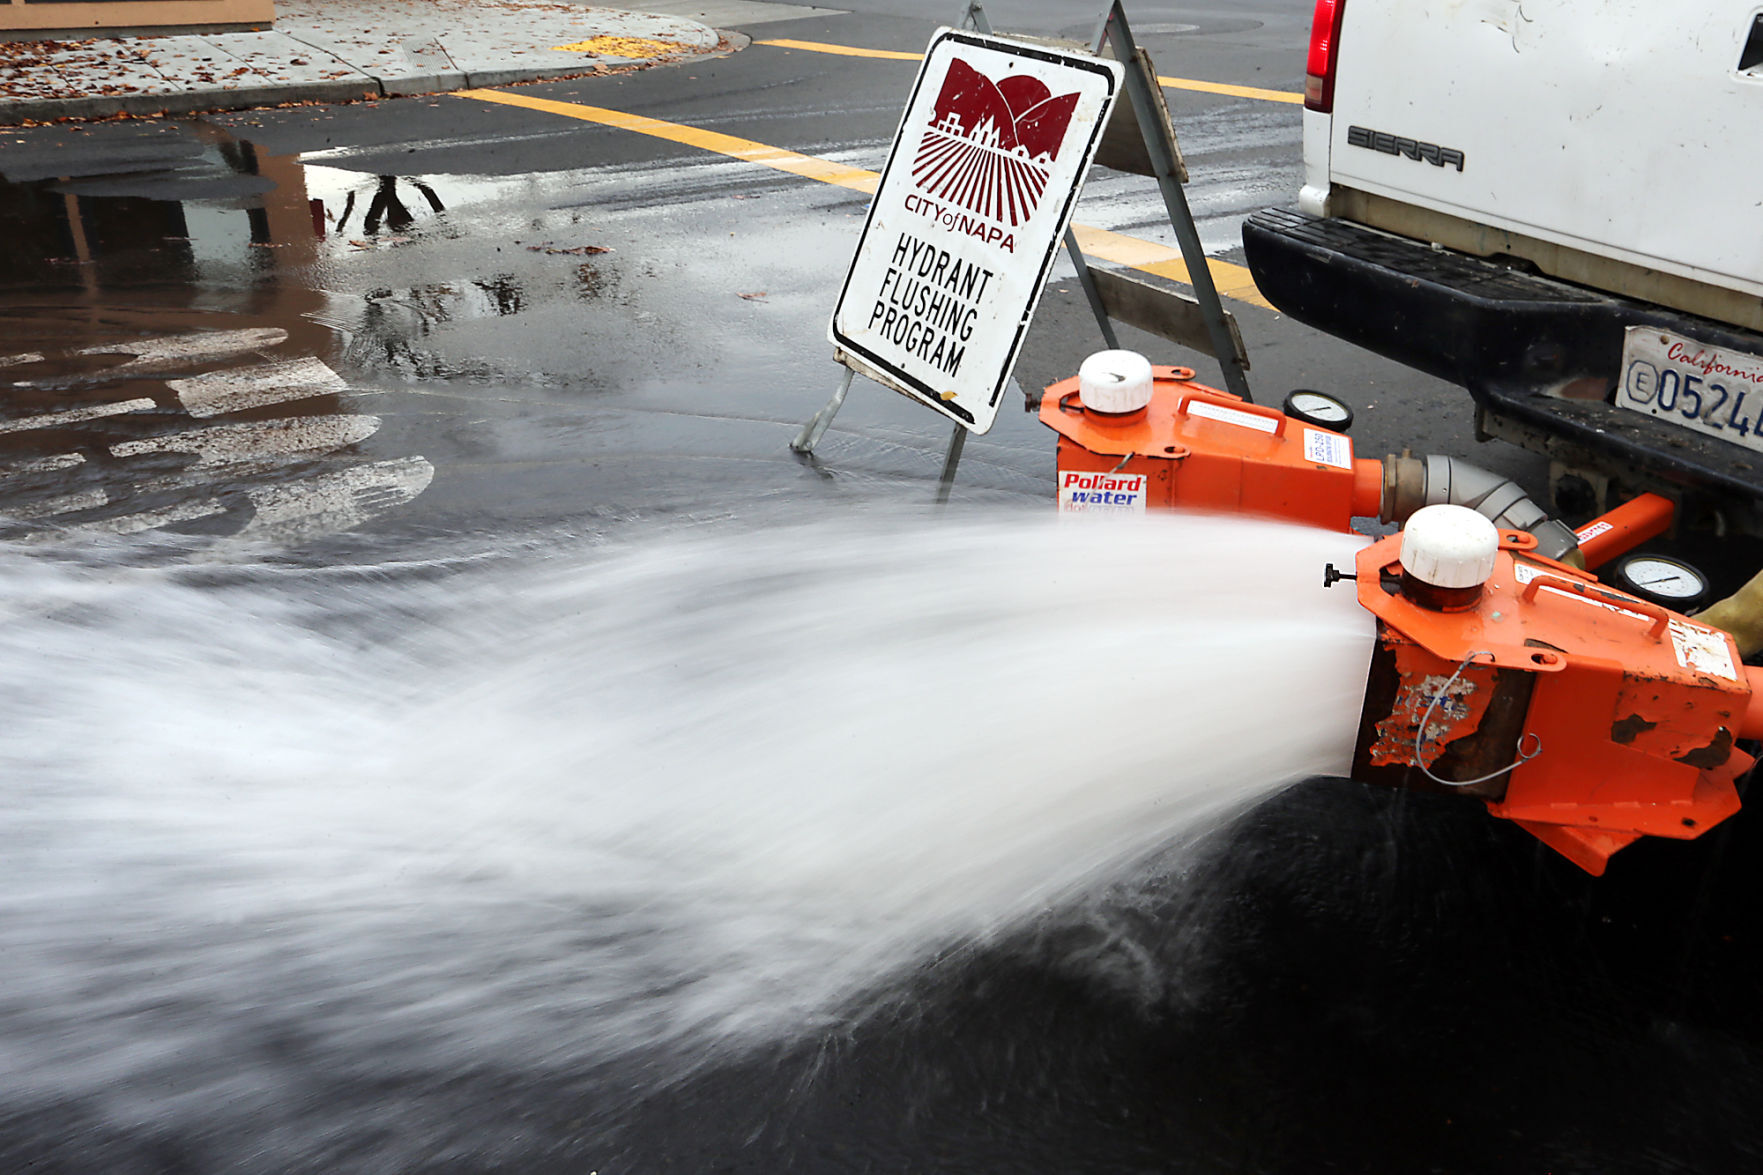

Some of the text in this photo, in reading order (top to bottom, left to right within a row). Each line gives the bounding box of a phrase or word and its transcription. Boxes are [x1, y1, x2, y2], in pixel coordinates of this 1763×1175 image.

[1347, 125, 1465, 172] SIERRA
[904, 194, 1014, 253] CITY of NAPA
[891, 232, 994, 304] HYDRANT
[879, 267, 978, 341] FLUSHING
[867, 299, 966, 378] PROGRAM
[1064, 473, 1142, 492] Pollard
[1072, 491, 1138, 506] water
